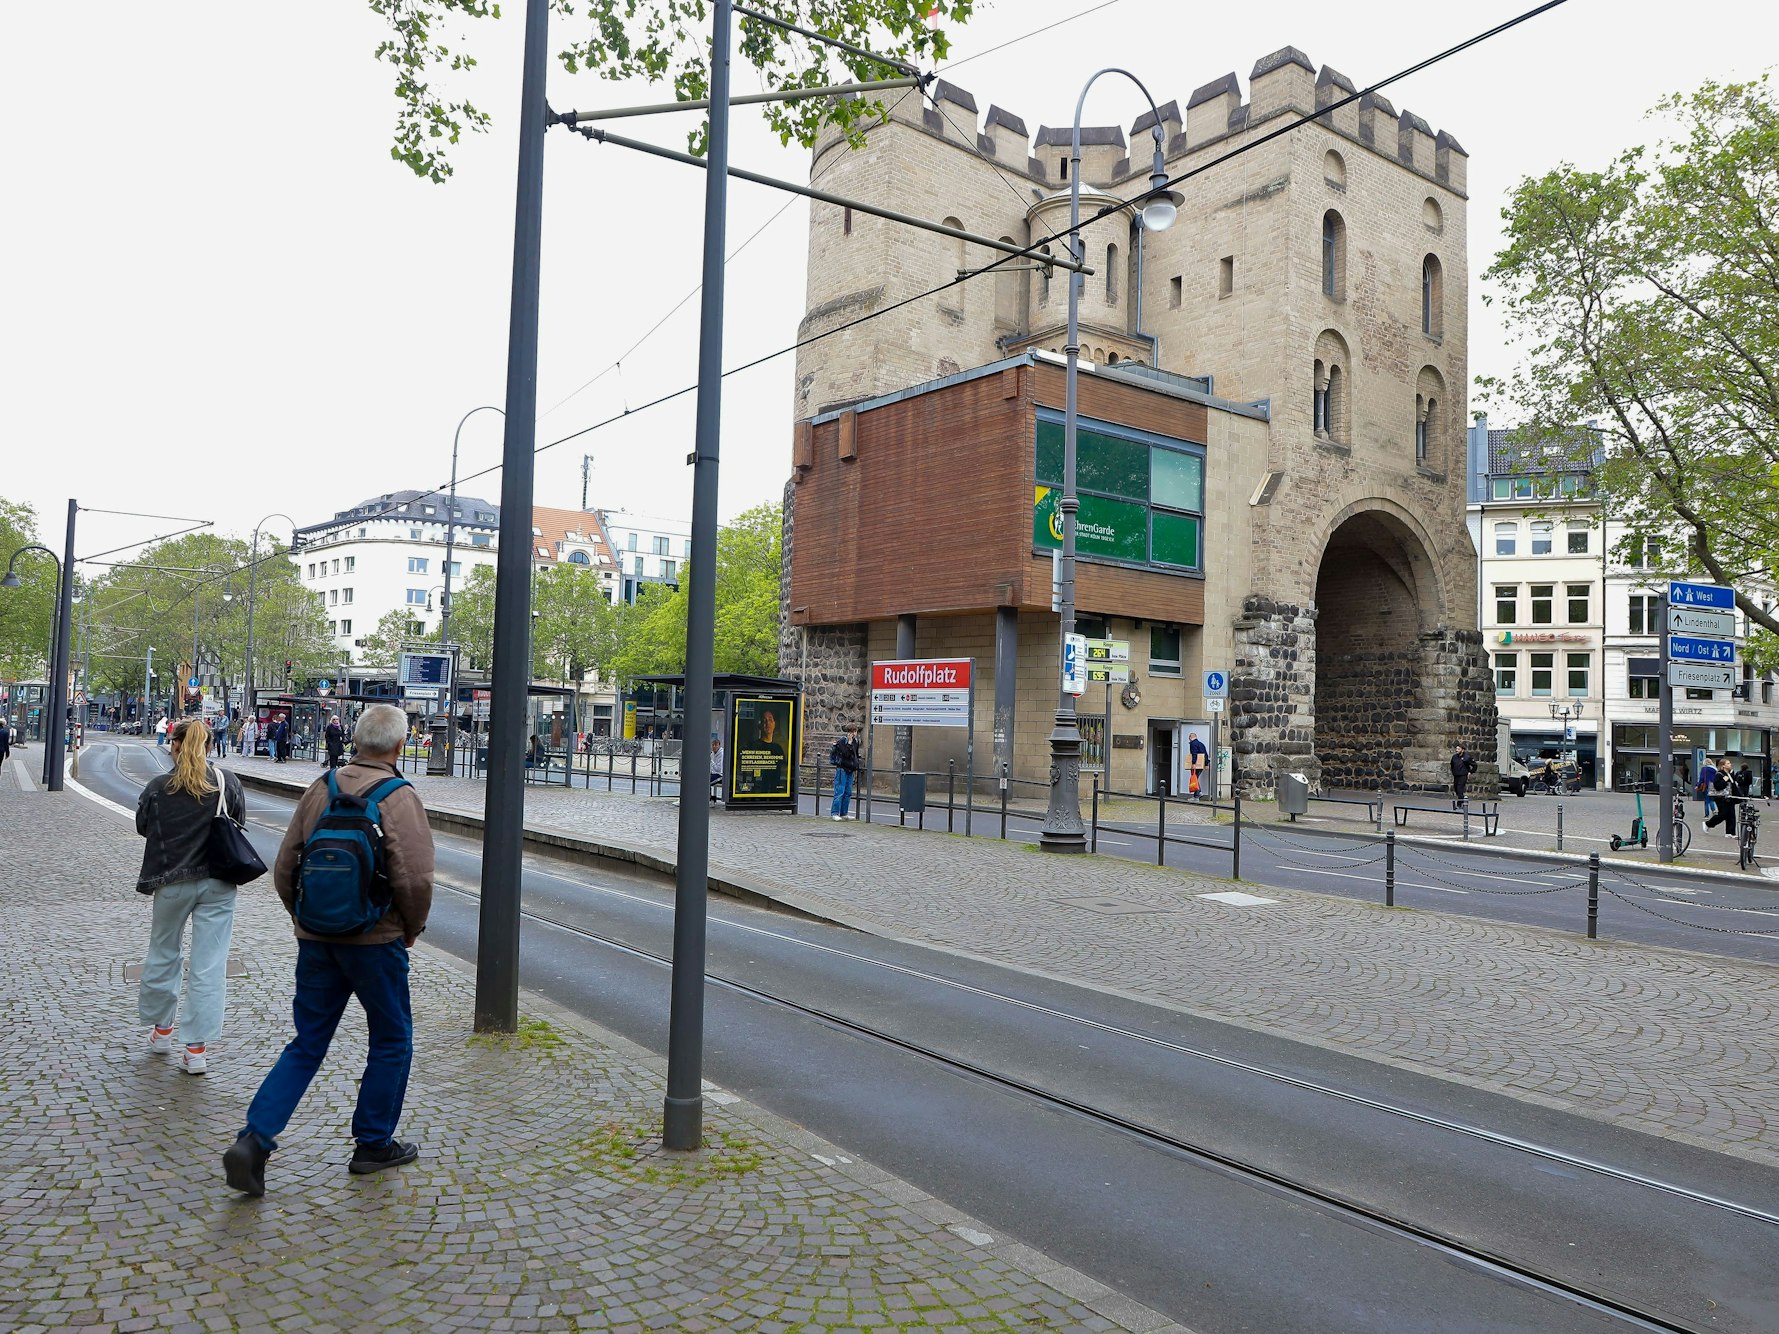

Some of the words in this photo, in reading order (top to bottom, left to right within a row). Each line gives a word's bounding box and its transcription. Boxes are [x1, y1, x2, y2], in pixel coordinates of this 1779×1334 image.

[1696, 590, 1713, 602] West
[1684, 616, 1720, 629] Lindenthal
[1093, 649, 1106, 658] 264
[1672, 642, 1690, 653] Nord
[1697, 644, 1710, 655] Ost
[884, 665, 957, 687] Rudolfplatz
[1092, 671, 1106, 681] 695
[1678, 670, 1721, 683] Friesenplatz
